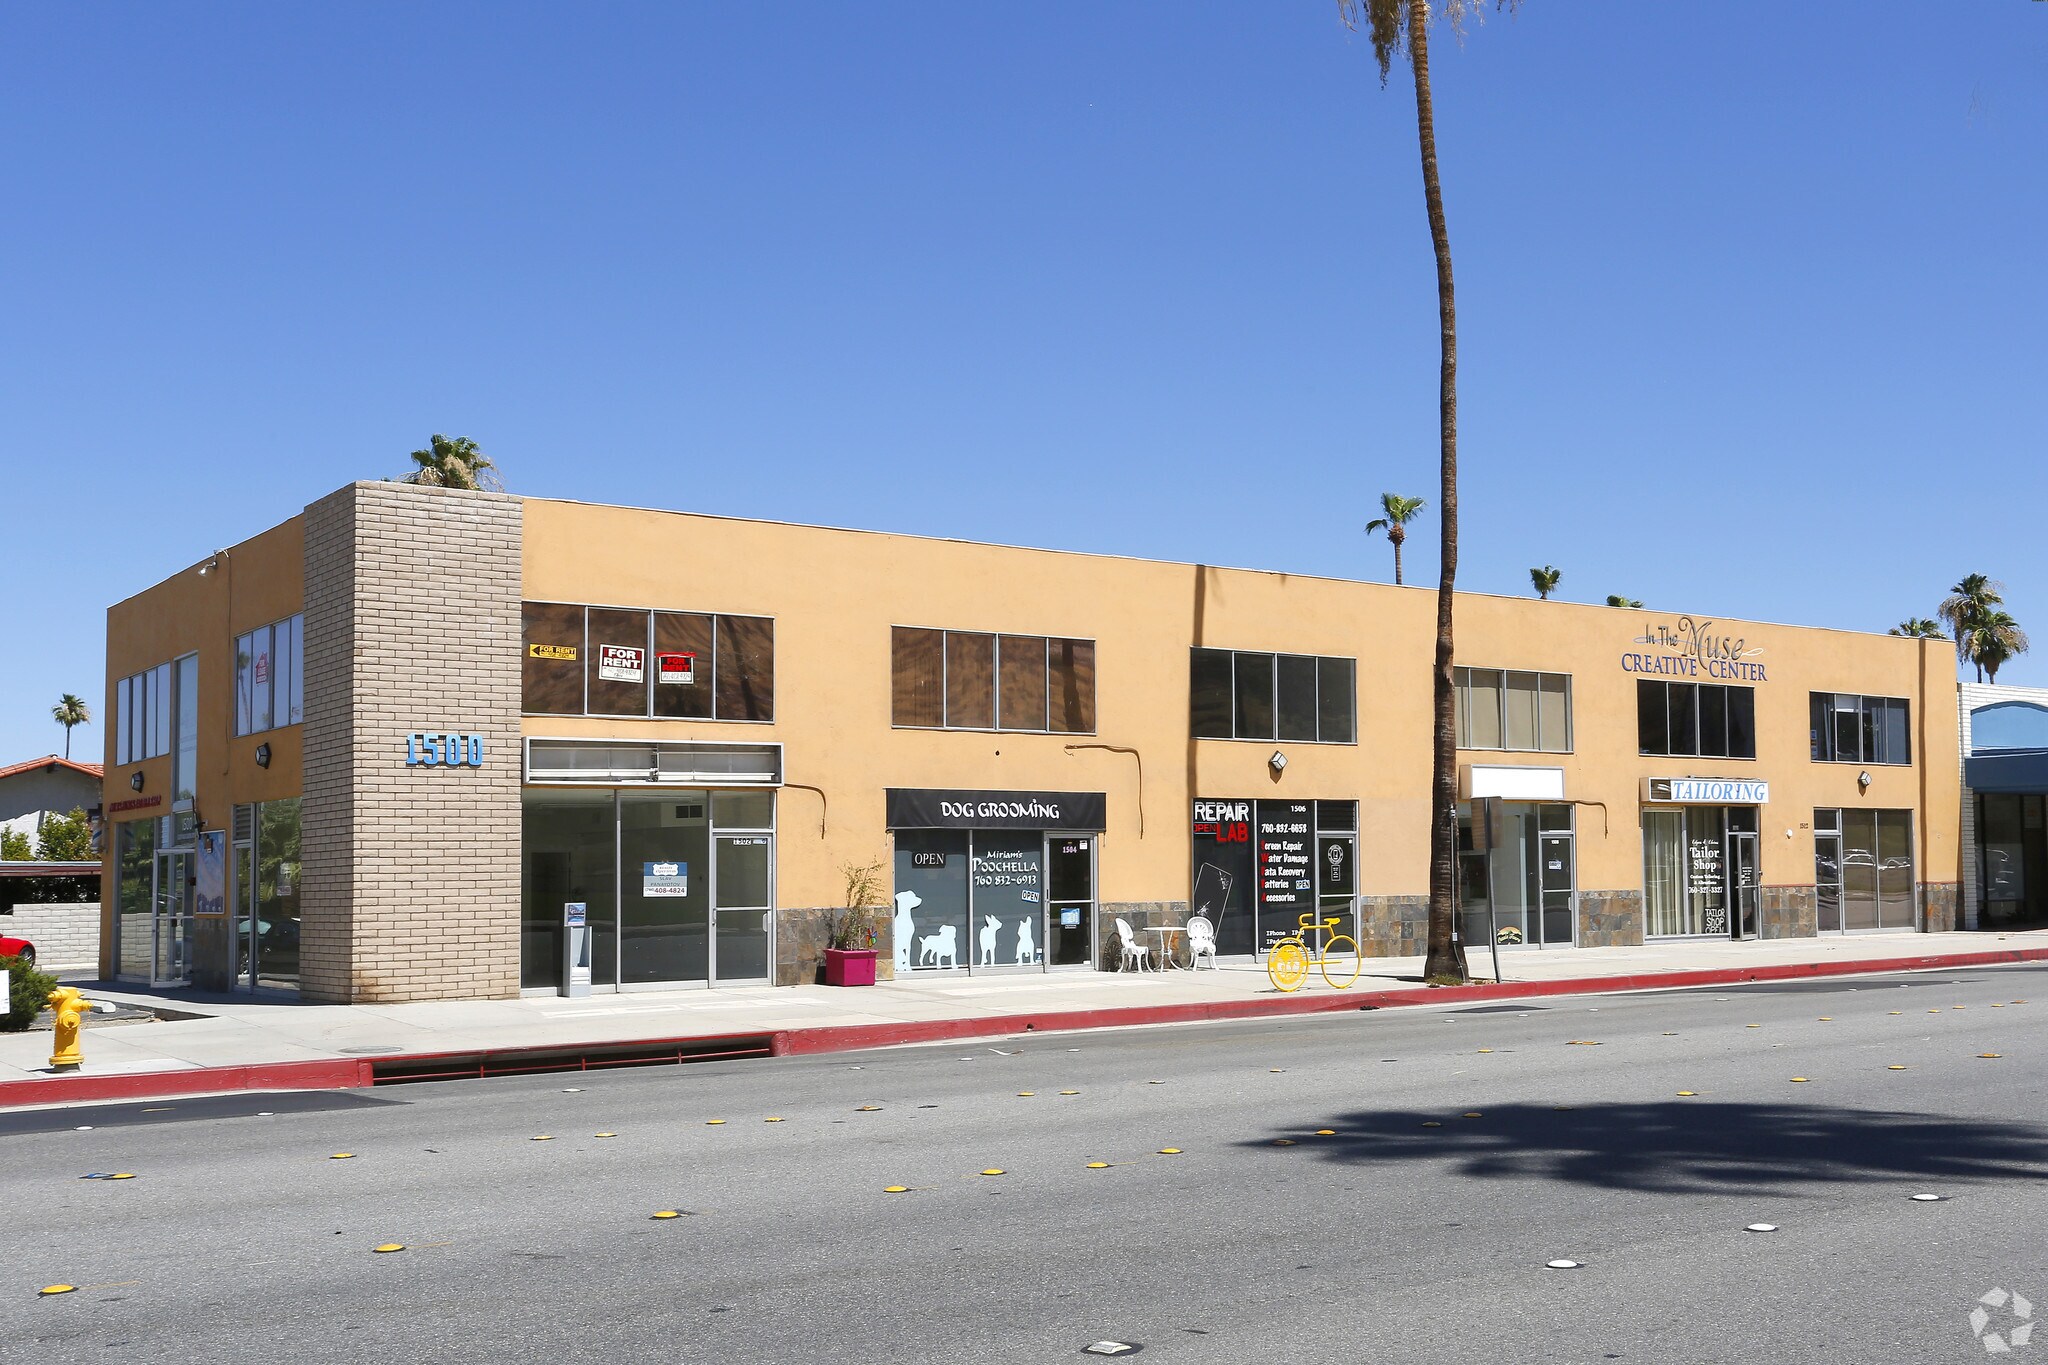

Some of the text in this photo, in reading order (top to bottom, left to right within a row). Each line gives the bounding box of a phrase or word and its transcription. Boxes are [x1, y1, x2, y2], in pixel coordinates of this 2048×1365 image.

[1658, 625, 1679, 647] The
[1678, 615, 1745, 671] Muse
[541, 645, 553, 653] FOR
[556, 647, 575, 655] RENT
[608, 648, 636, 660] FOR
[603, 657, 640, 669] RENT
[667, 657, 685, 665] FOR
[662, 664, 690, 672] RENT
[1621, 653, 1768, 682] CREATIVE CENTER
[406, 732, 483, 767] 1500
[1673, 782, 1765, 800] TAILORING
[940, 801, 975, 818] DOG
[1194, 801, 1249, 822] REPAIR
[1216, 822, 1249, 842] LAB
[1062, 846, 1077, 854] 1504
[1282, 840, 1304, 852] Repair
[1689, 846, 1720, 858] Tailor
[914, 853, 945, 865] OPEN
[986, 850, 1024, 859] Miriam's
[1260, 853, 1309, 864] Water Damage
[971, 857, 1039, 873] POOCHELLA
[1693, 859, 1717, 873] Shop
[1277, 866, 1306, 877] Recovery
[974, 874, 1037, 886] 760 832-6913
[1022, 890, 1039, 901] OPEN
[1261, 892, 1296, 902] Accessories
[1705, 908, 1726, 918] TAILOR
[1706, 917, 1725, 927] SHOP
